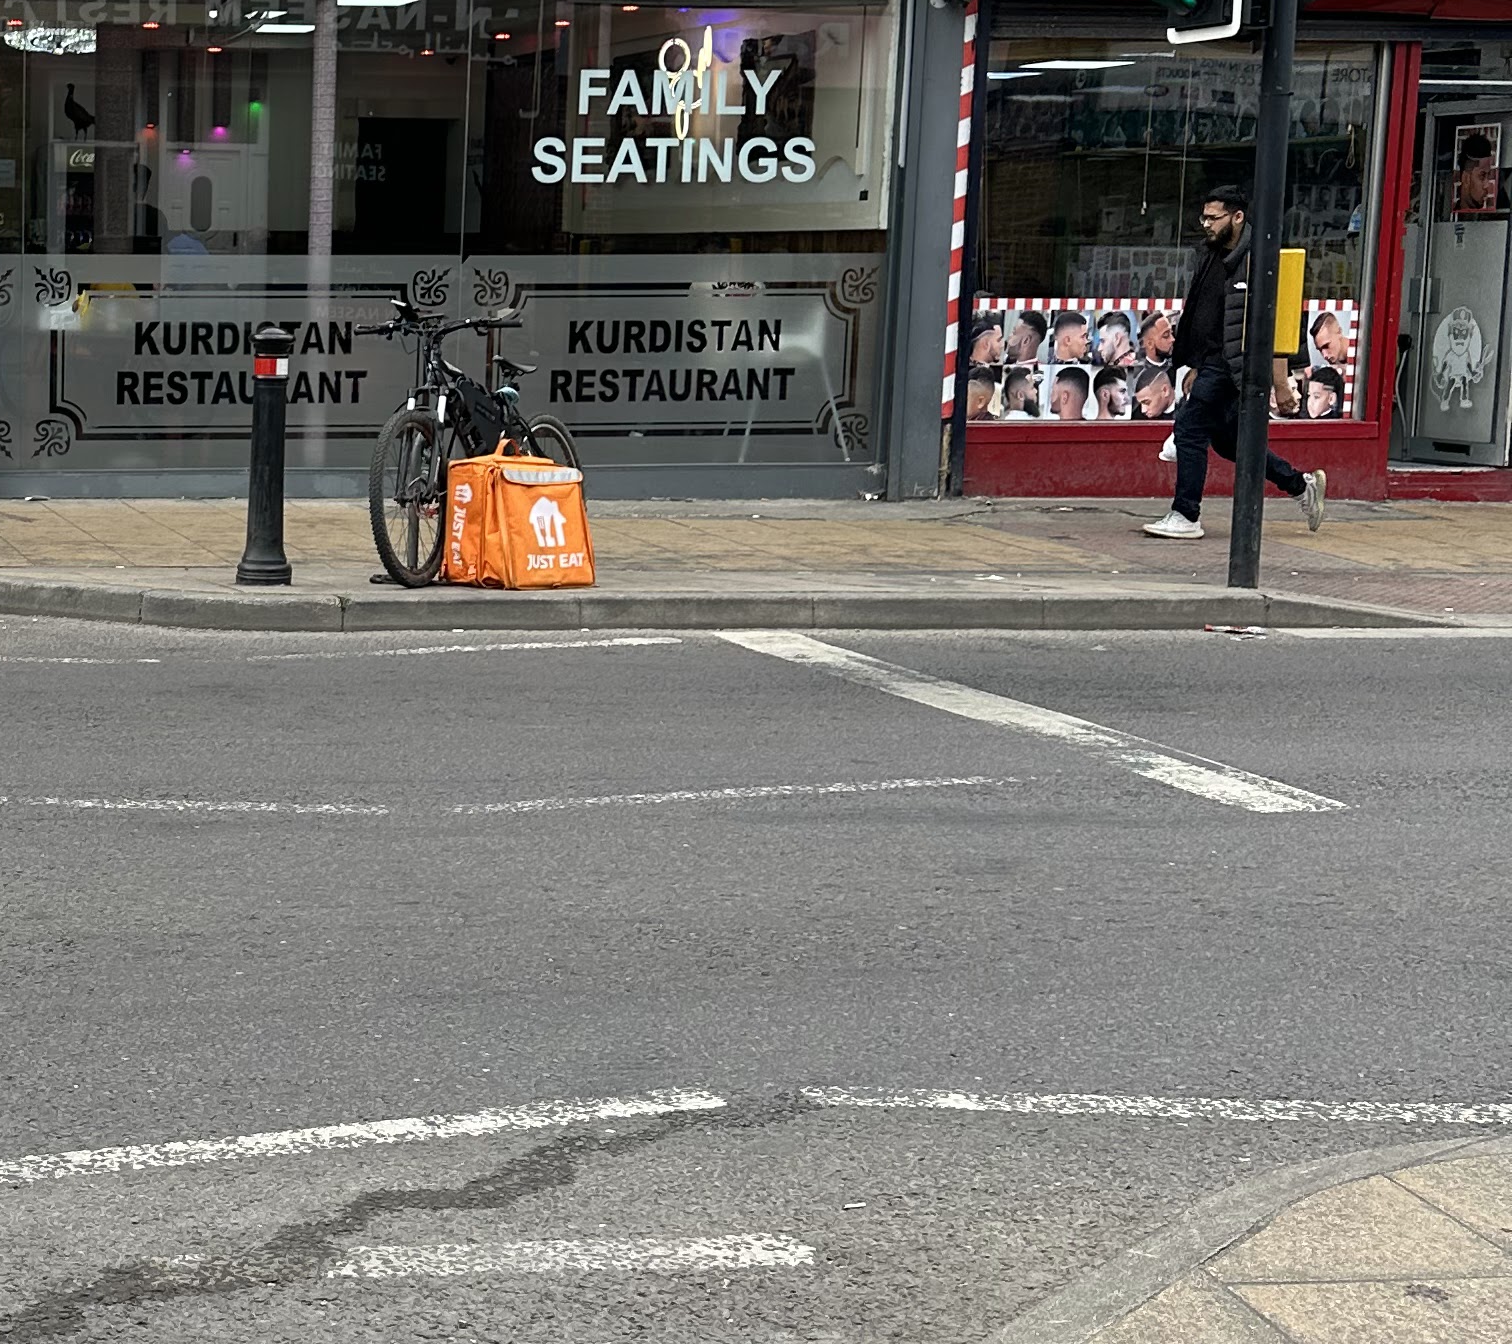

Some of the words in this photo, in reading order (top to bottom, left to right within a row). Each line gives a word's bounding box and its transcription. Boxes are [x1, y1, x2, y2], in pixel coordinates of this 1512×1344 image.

[578, 68, 781, 116] FAMILY
[531, 137, 816, 184] SEATINGS
[134, 321, 353, 355] KURDITAN
[568, 319, 782, 354] KURDISTAN
[116, 370, 368, 405] RESTAUANT
[549, 367, 795, 403] RESTAURANT
[452, 504, 467, 541] JUST
[526, 553, 556, 571] JUST
[559, 552, 585, 568] EAT
